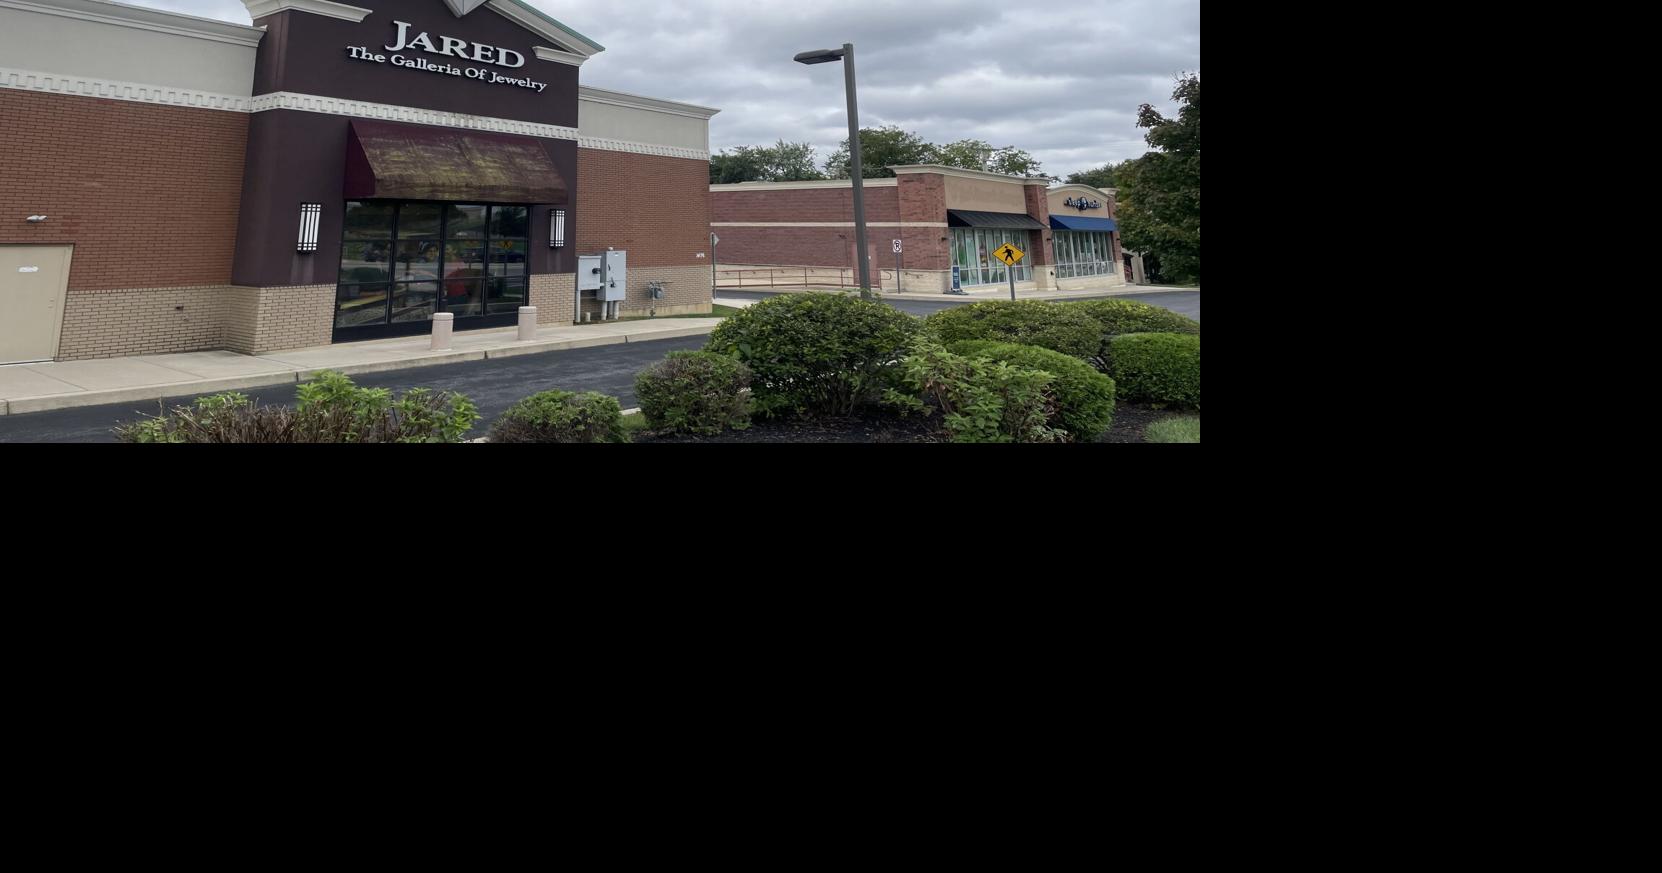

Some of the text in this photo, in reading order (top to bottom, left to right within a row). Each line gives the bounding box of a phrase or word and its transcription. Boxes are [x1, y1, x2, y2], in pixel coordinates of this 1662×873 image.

[384, 20, 526, 68] JARED
[346, 45, 548, 93] The Galleria Of Jewelry
